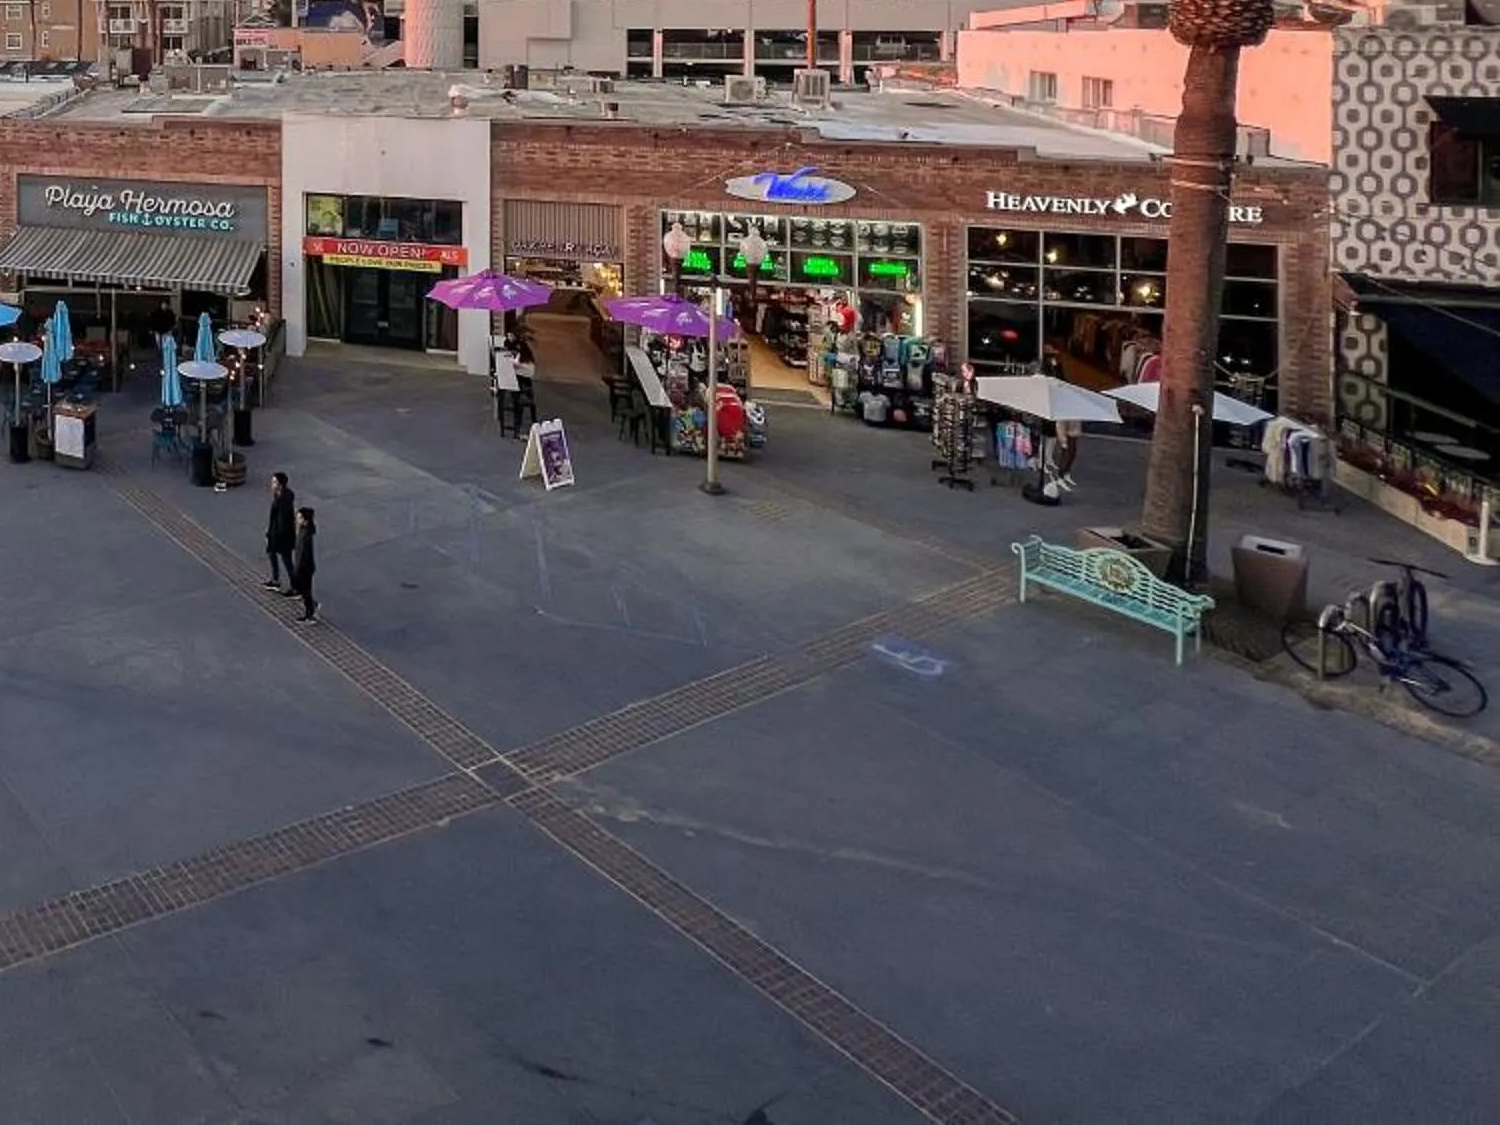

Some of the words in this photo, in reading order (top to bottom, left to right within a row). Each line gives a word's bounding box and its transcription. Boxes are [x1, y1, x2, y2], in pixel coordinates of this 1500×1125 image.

[44, 184, 115, 216] Playa
[120, 189, 234, 218] Hermosa
[986, 190, 1112, 215] HEAVENLY
[1140, 198, 1263, 222] CORE
[108, 211, 139, 223] FISH
[155, 215, 206, 229] OYSTER
[210, 217, 235, 231] CO.
[336, 242, 373, 255] NOW
[377, 244, 426, 259] OPEN!
